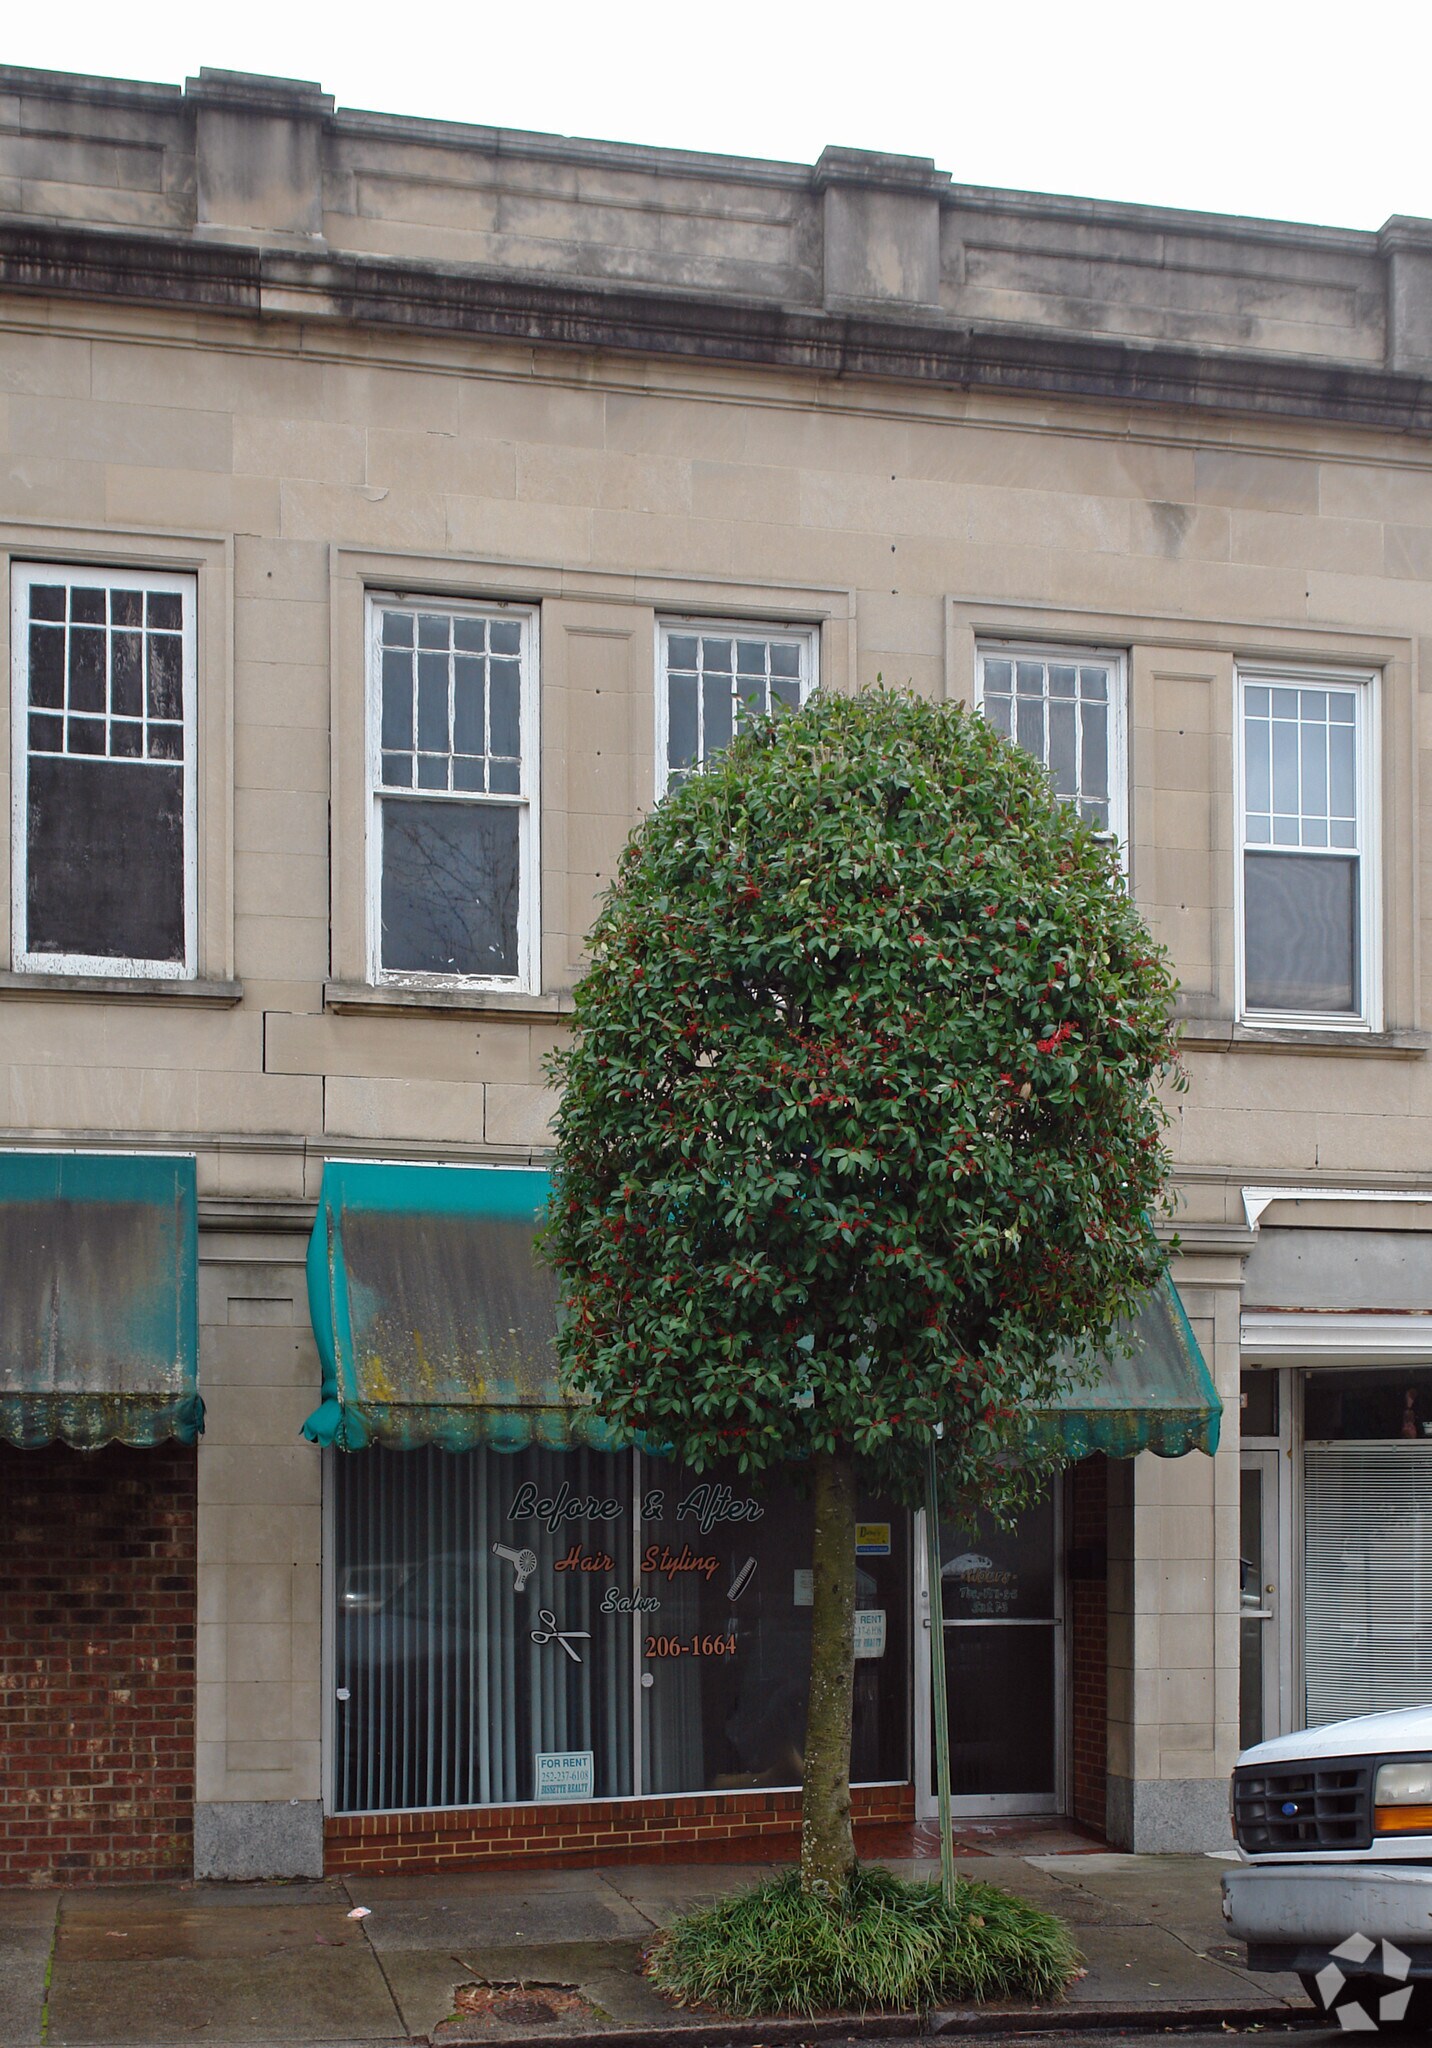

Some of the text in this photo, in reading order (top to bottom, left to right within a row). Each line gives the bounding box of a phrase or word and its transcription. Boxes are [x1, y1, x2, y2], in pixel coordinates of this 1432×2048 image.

[507, 1481, 764, 1535] Before & After
[554, 1543, 721, 1581] Hair Styling
[860, 1615, 883, 1624] RENT
[645, 1633, 737, 1658] 206-1664
[541, 1758, 588, 1769] FOR RENT
